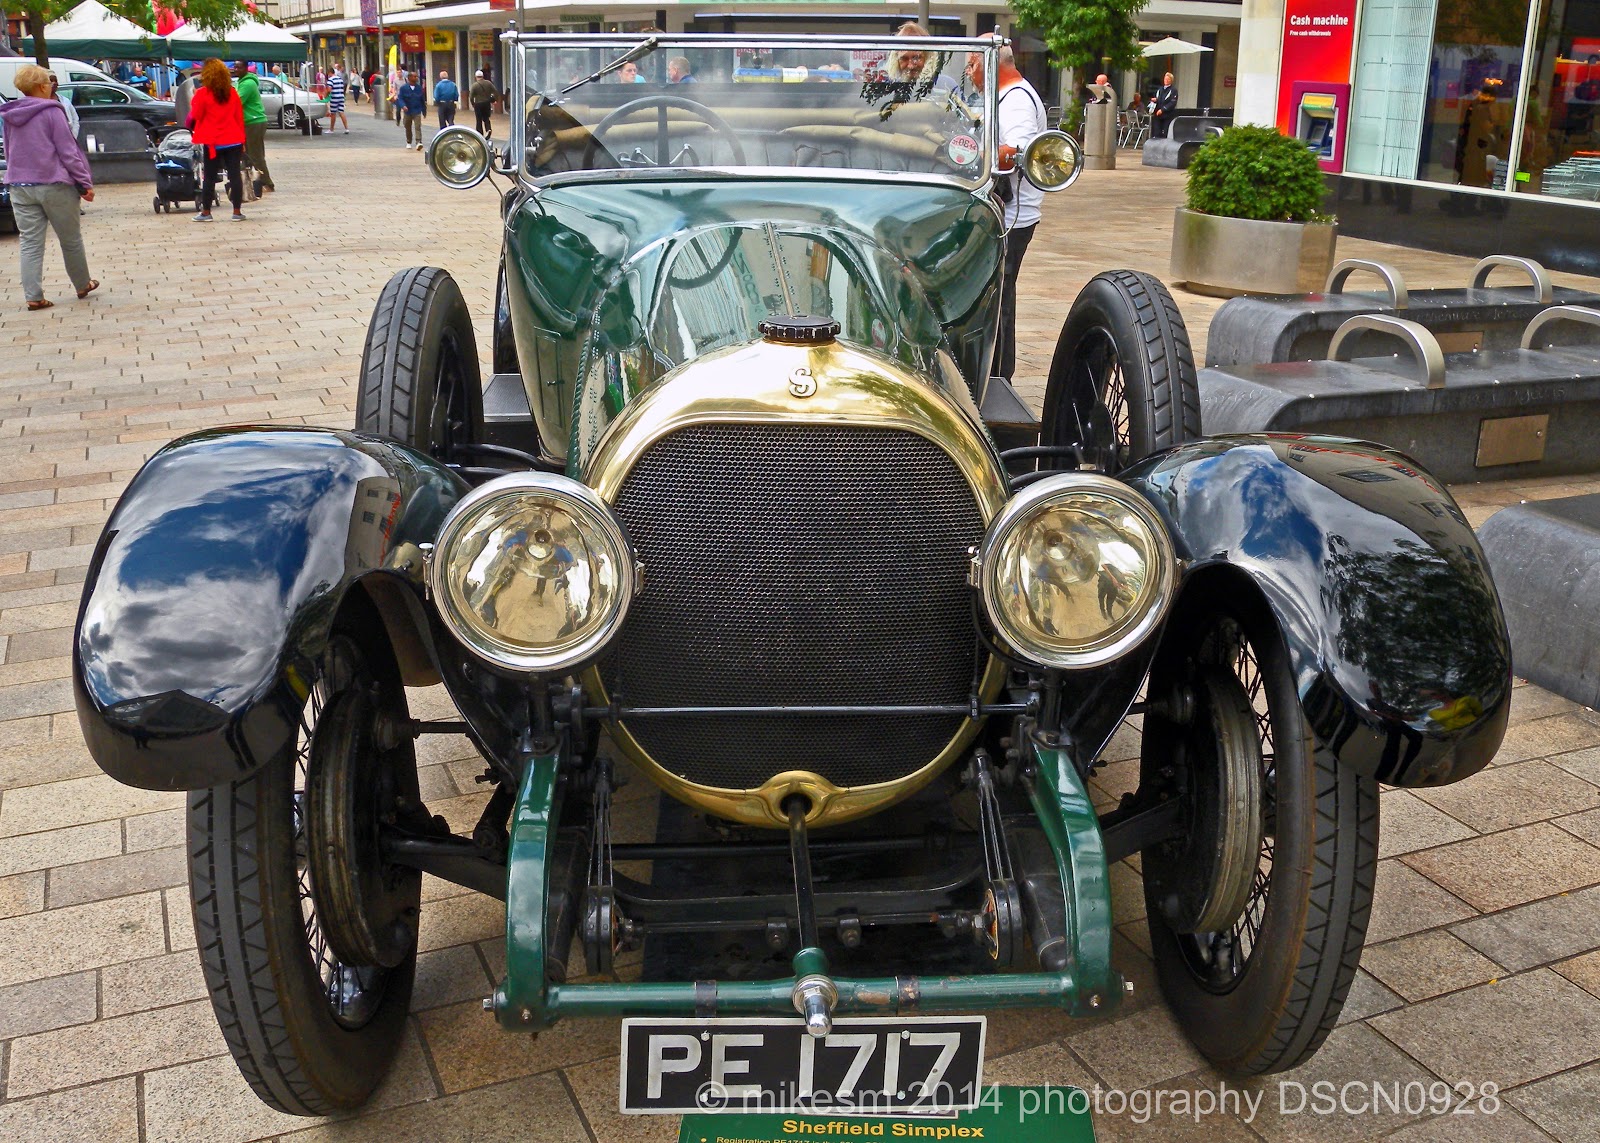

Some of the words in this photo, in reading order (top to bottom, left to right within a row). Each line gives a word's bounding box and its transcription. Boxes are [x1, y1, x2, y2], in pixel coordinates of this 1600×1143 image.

[1290, 14, 1311, 26] Cash
[1312, 14, 1349, 26] machine
[788, 367, 818, 399] S
[647, 1034, 764, 1099] PE
[801, 1032, 961, 1099] 1717
[782, 1119, 884, 1136] Sheffield
[891, 1122, 985, 1140] Simplex
